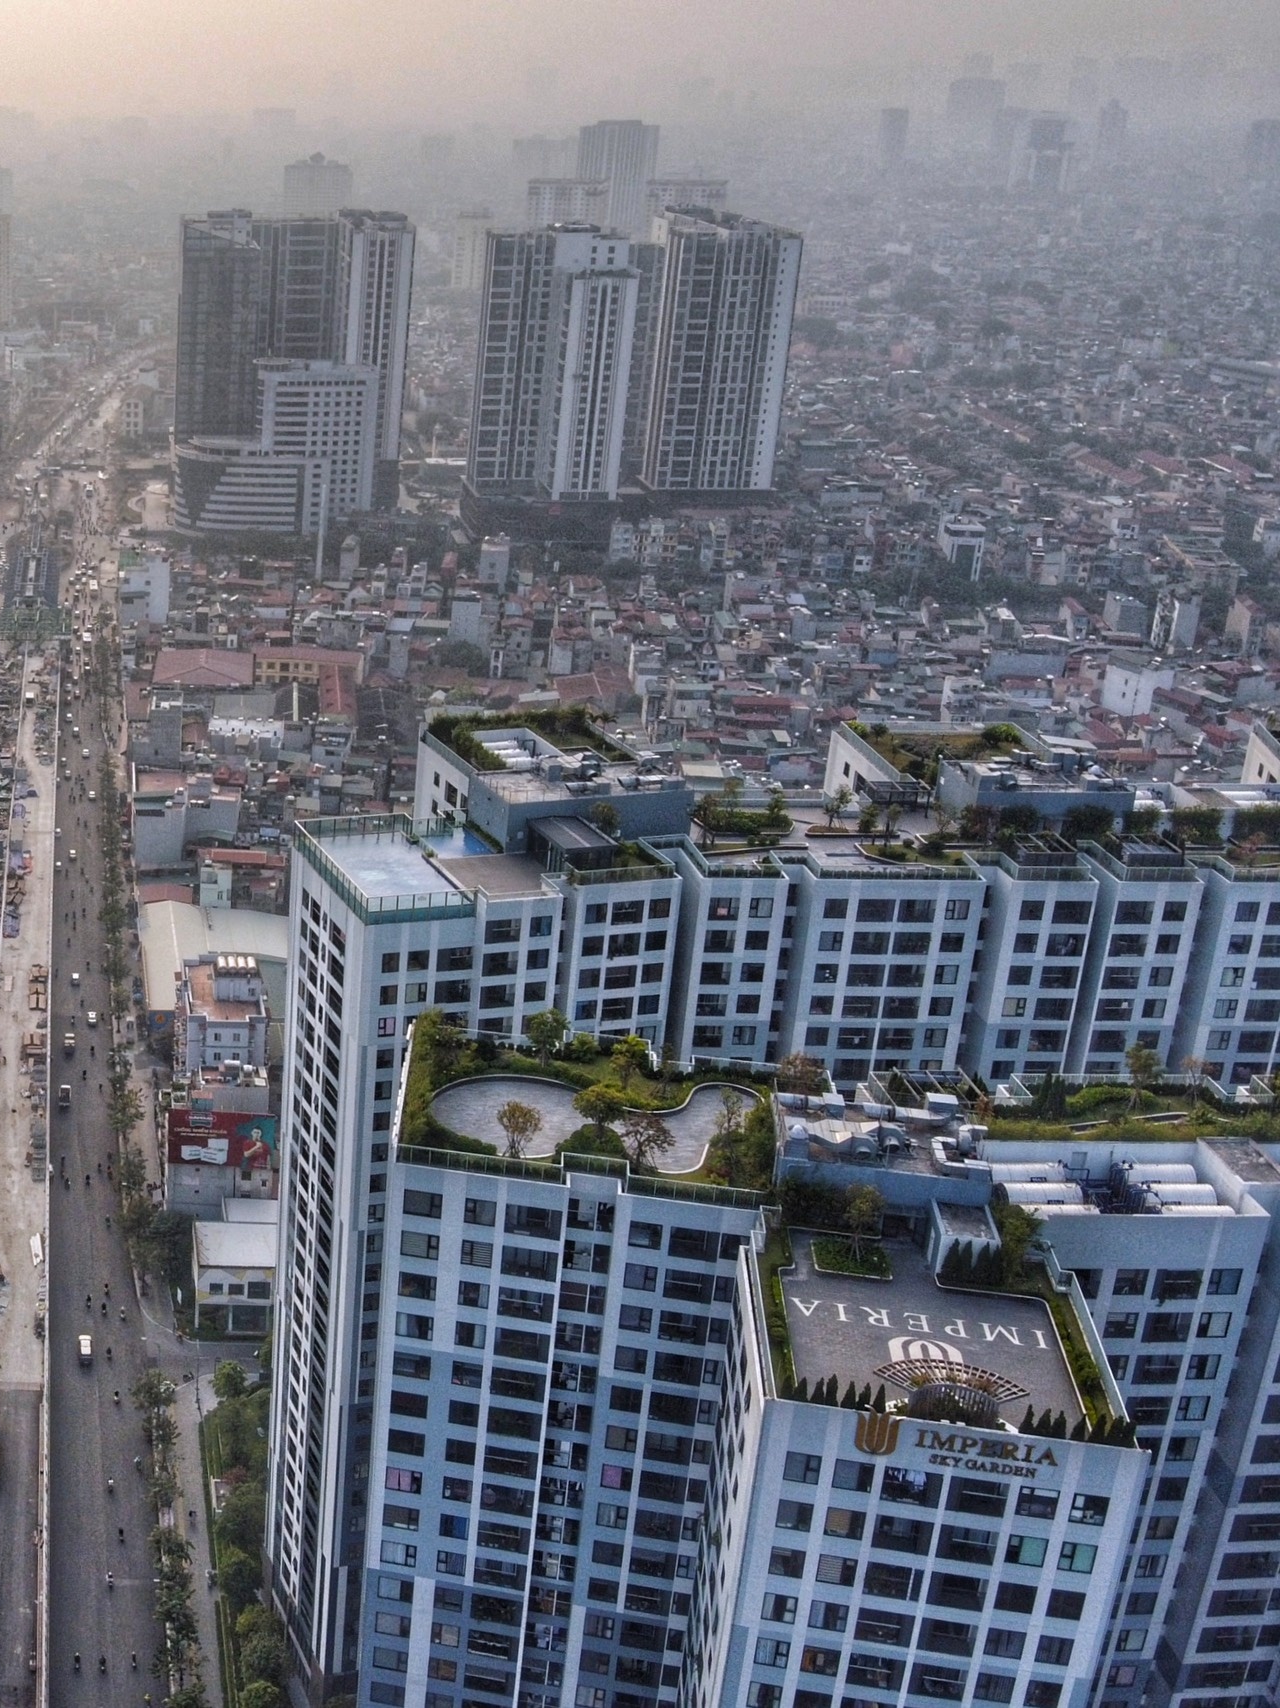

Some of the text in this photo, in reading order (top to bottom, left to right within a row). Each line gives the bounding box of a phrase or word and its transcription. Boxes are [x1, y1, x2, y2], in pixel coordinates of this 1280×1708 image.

[790, 1297, 1050, 1349] IMPERIA
[915, 1428, 1058, 1467] IMPERIA
[929, 1453, 1037, 1479] SKY GARDEN
